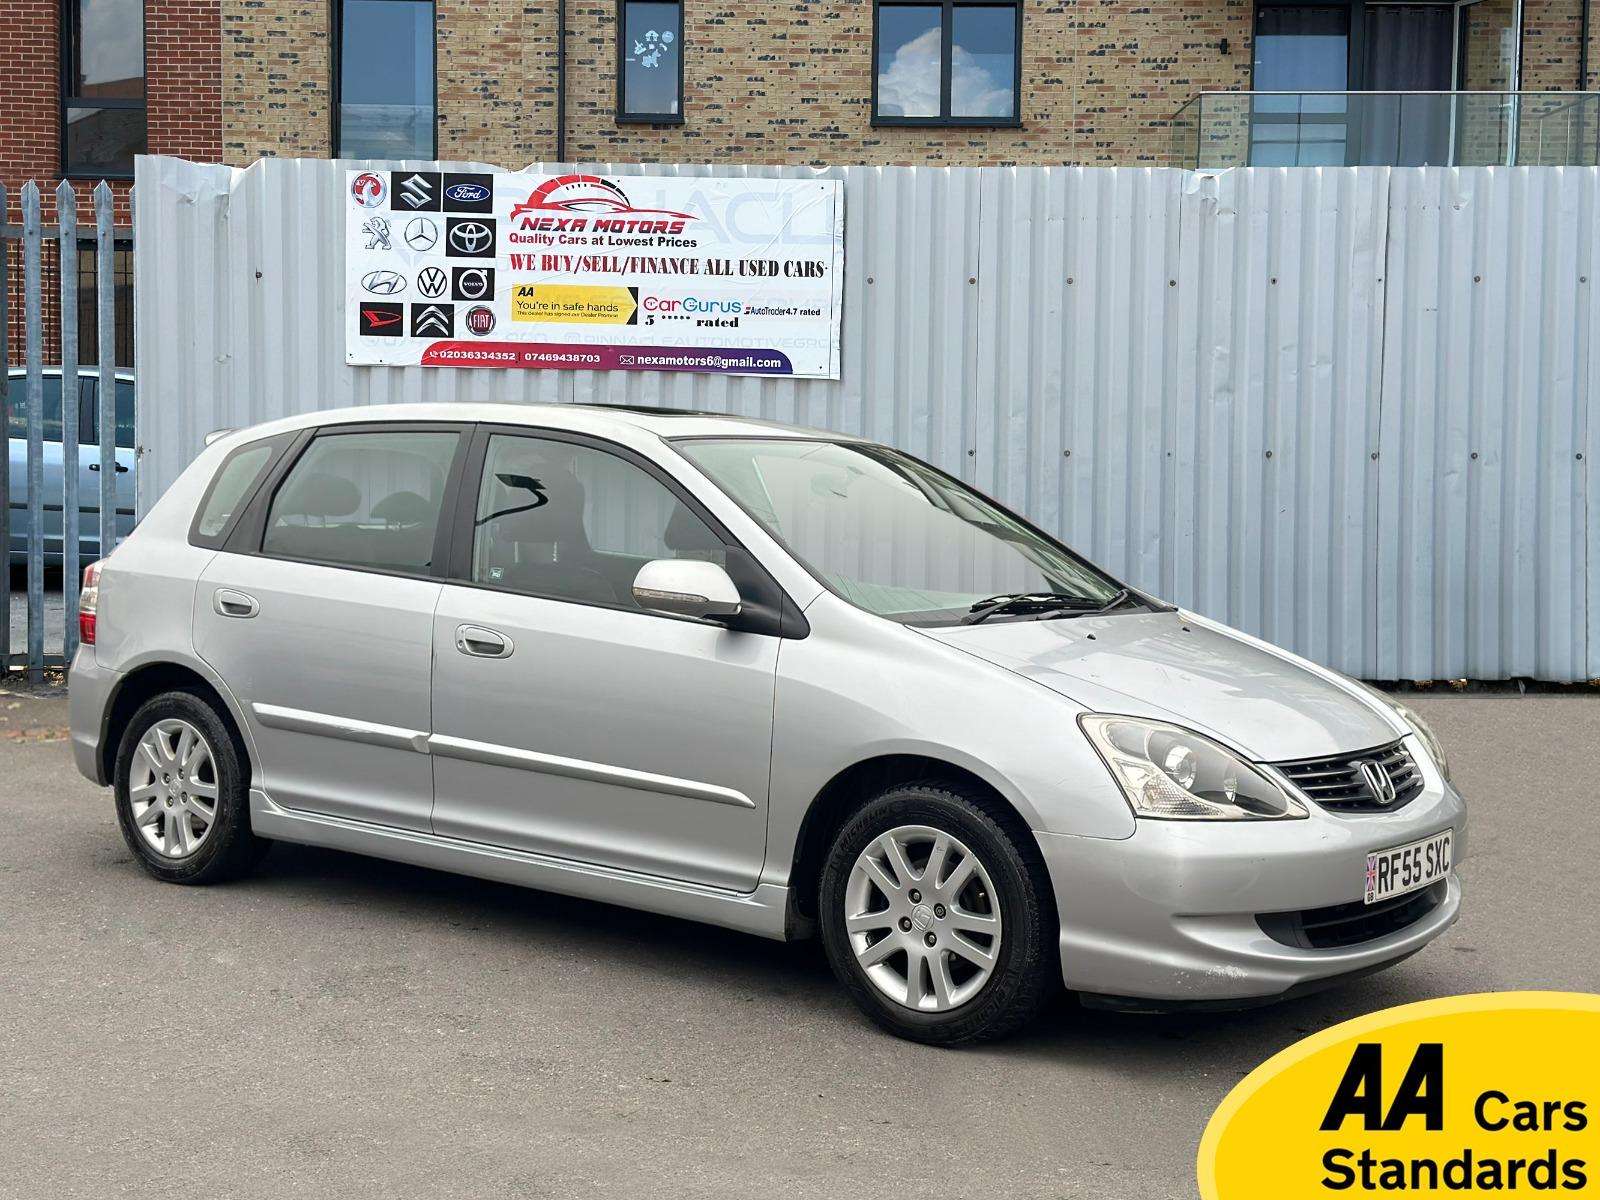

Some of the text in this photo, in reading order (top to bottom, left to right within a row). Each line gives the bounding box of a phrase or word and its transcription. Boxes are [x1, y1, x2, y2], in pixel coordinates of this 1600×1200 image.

[454, 186, 481, 199] Ford
[520, 217, 685, 234] NEXA MOTORS
[509, 232, 697, 247] Quality Cars at Lowest Prices
[509, 254, 824, 278] WE BUY/SELL/FINANCE ALL USED CARS
[518, 286, 534, 297] AA
[516, 300, 619, 312] You're in safe hands
[643, 296, 742, 314] CarGurus
[799, 308, 821, 316] rated
[473, 314, 490, 328] FIAT
[645, 314, 739, 328] 5 rated
[440, 351, 601, 363] 02036334352 07469438703
[637, 355, 782, 369] nexamotors6@gmail.com
[1378, 837, 1450, 894] RF55 SXC
